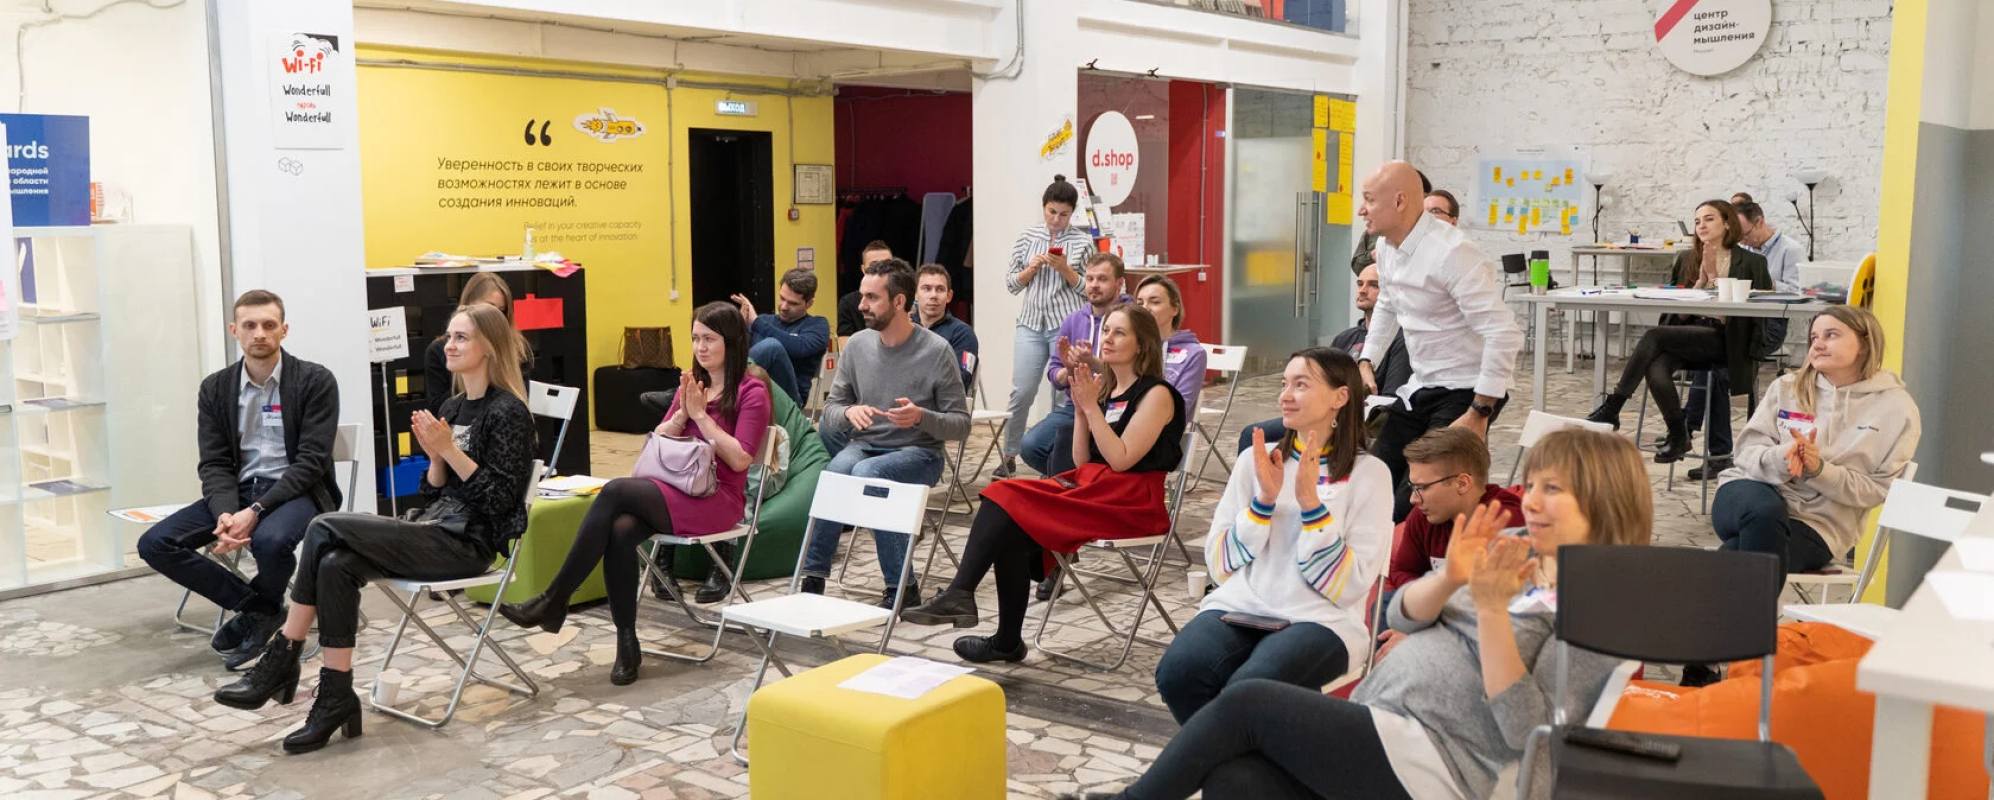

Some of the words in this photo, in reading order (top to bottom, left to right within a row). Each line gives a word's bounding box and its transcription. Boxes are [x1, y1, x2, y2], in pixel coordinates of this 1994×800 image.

[1694, 10, 1728, 21] центр
[1694, 20, 1739, 33] дизайн-
[1694, 32, 1755, 44] мышления
[283, 84, 331, 96] Wonderfull
[286, 111, 331, 123] Wonderfull
[438, 156, 523, 173] Уверенность
[527, 161, 534, 171] в
[537, 162, 572, 172] своих
[577, 161, 643, 174] творческих
[1092, 149, 1133, 171] d.shop
[438, 179, 530, 190] возможностях
[535, 179, 571, 190] лежит
[575, 181, 582, 190] в
[584, 181, 627, 190] основе
[439, 198, 502, 208] создания
[506, 195, 577, 209] инноваций.
